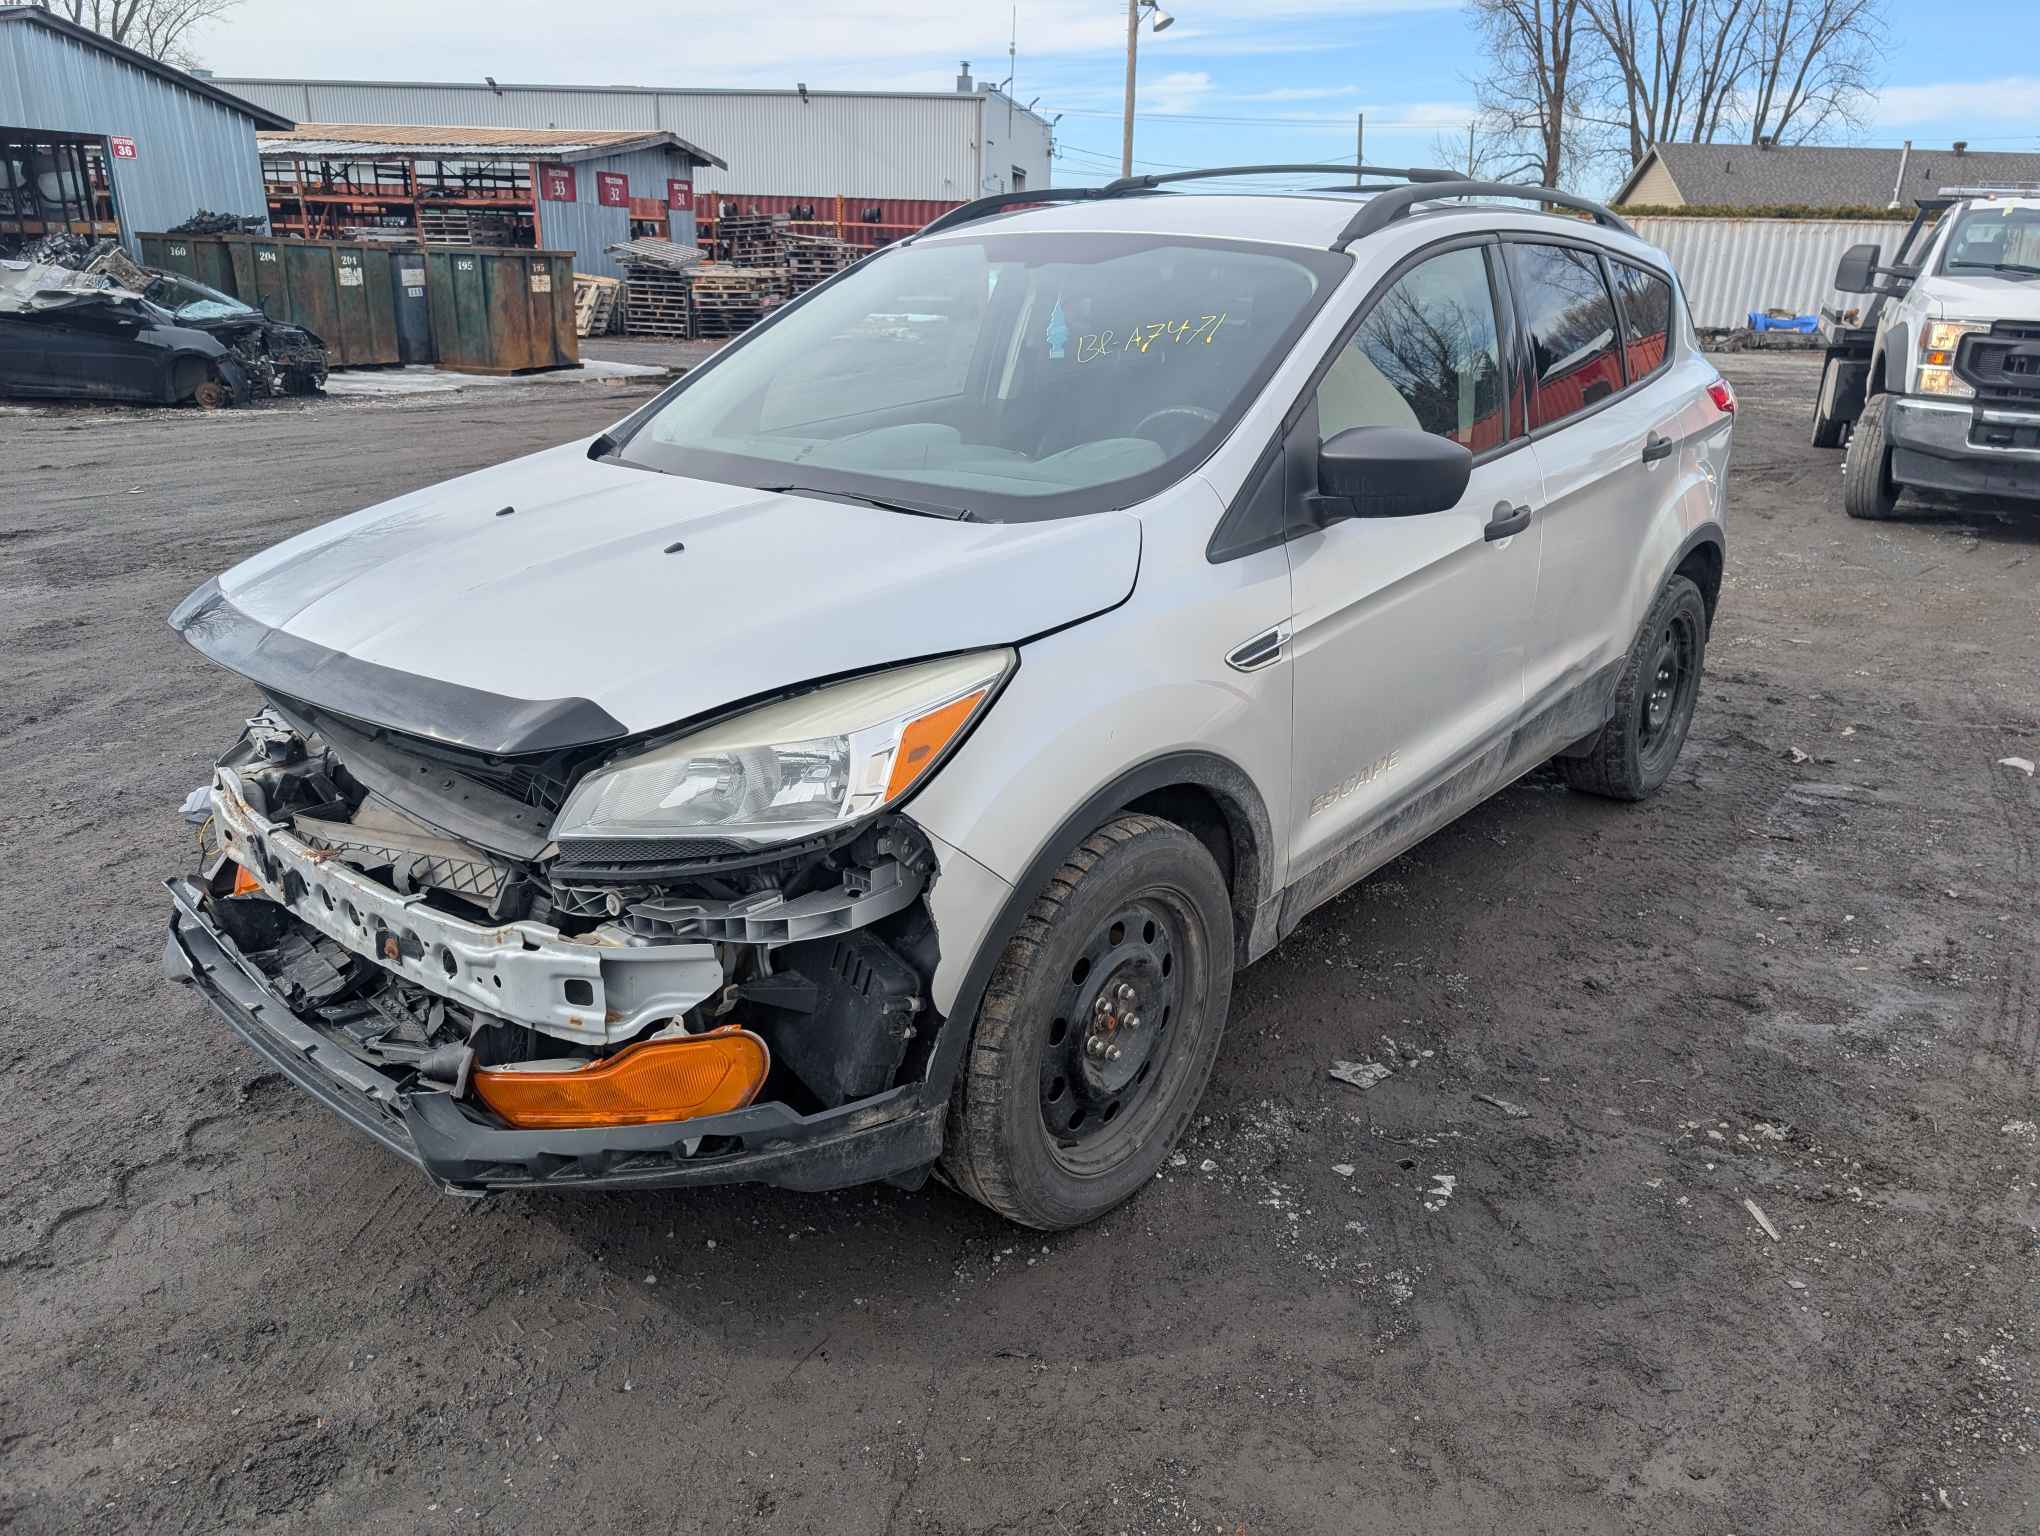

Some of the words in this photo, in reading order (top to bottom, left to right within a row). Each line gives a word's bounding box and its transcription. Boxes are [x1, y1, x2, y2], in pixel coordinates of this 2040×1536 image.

[118, 145, 133, 156] 36
[553, 180, 566, 196] 33
[610, 187, 620, 201] 32
[259, 251, 276, 262] 204
[457, 260, 473, 271] 195
